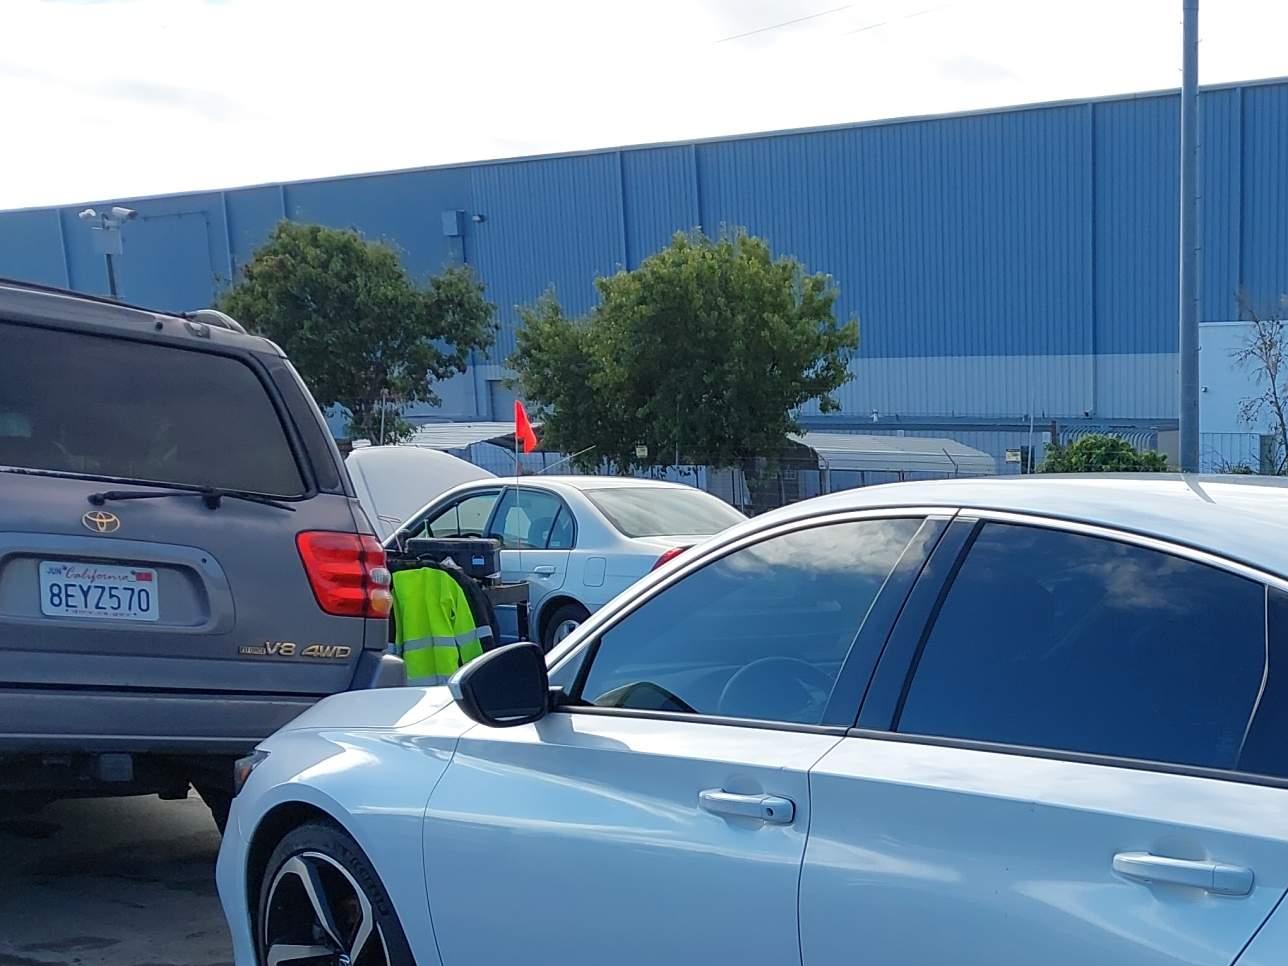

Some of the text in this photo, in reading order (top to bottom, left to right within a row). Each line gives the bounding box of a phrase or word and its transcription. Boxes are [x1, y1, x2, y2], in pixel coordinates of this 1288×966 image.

[65, 567, 129, 583] California
[49, 583, 150, 612] 8EYZ570
[265, 641, 296, 656] V8
[301, 644, 351, 658] 4WD
